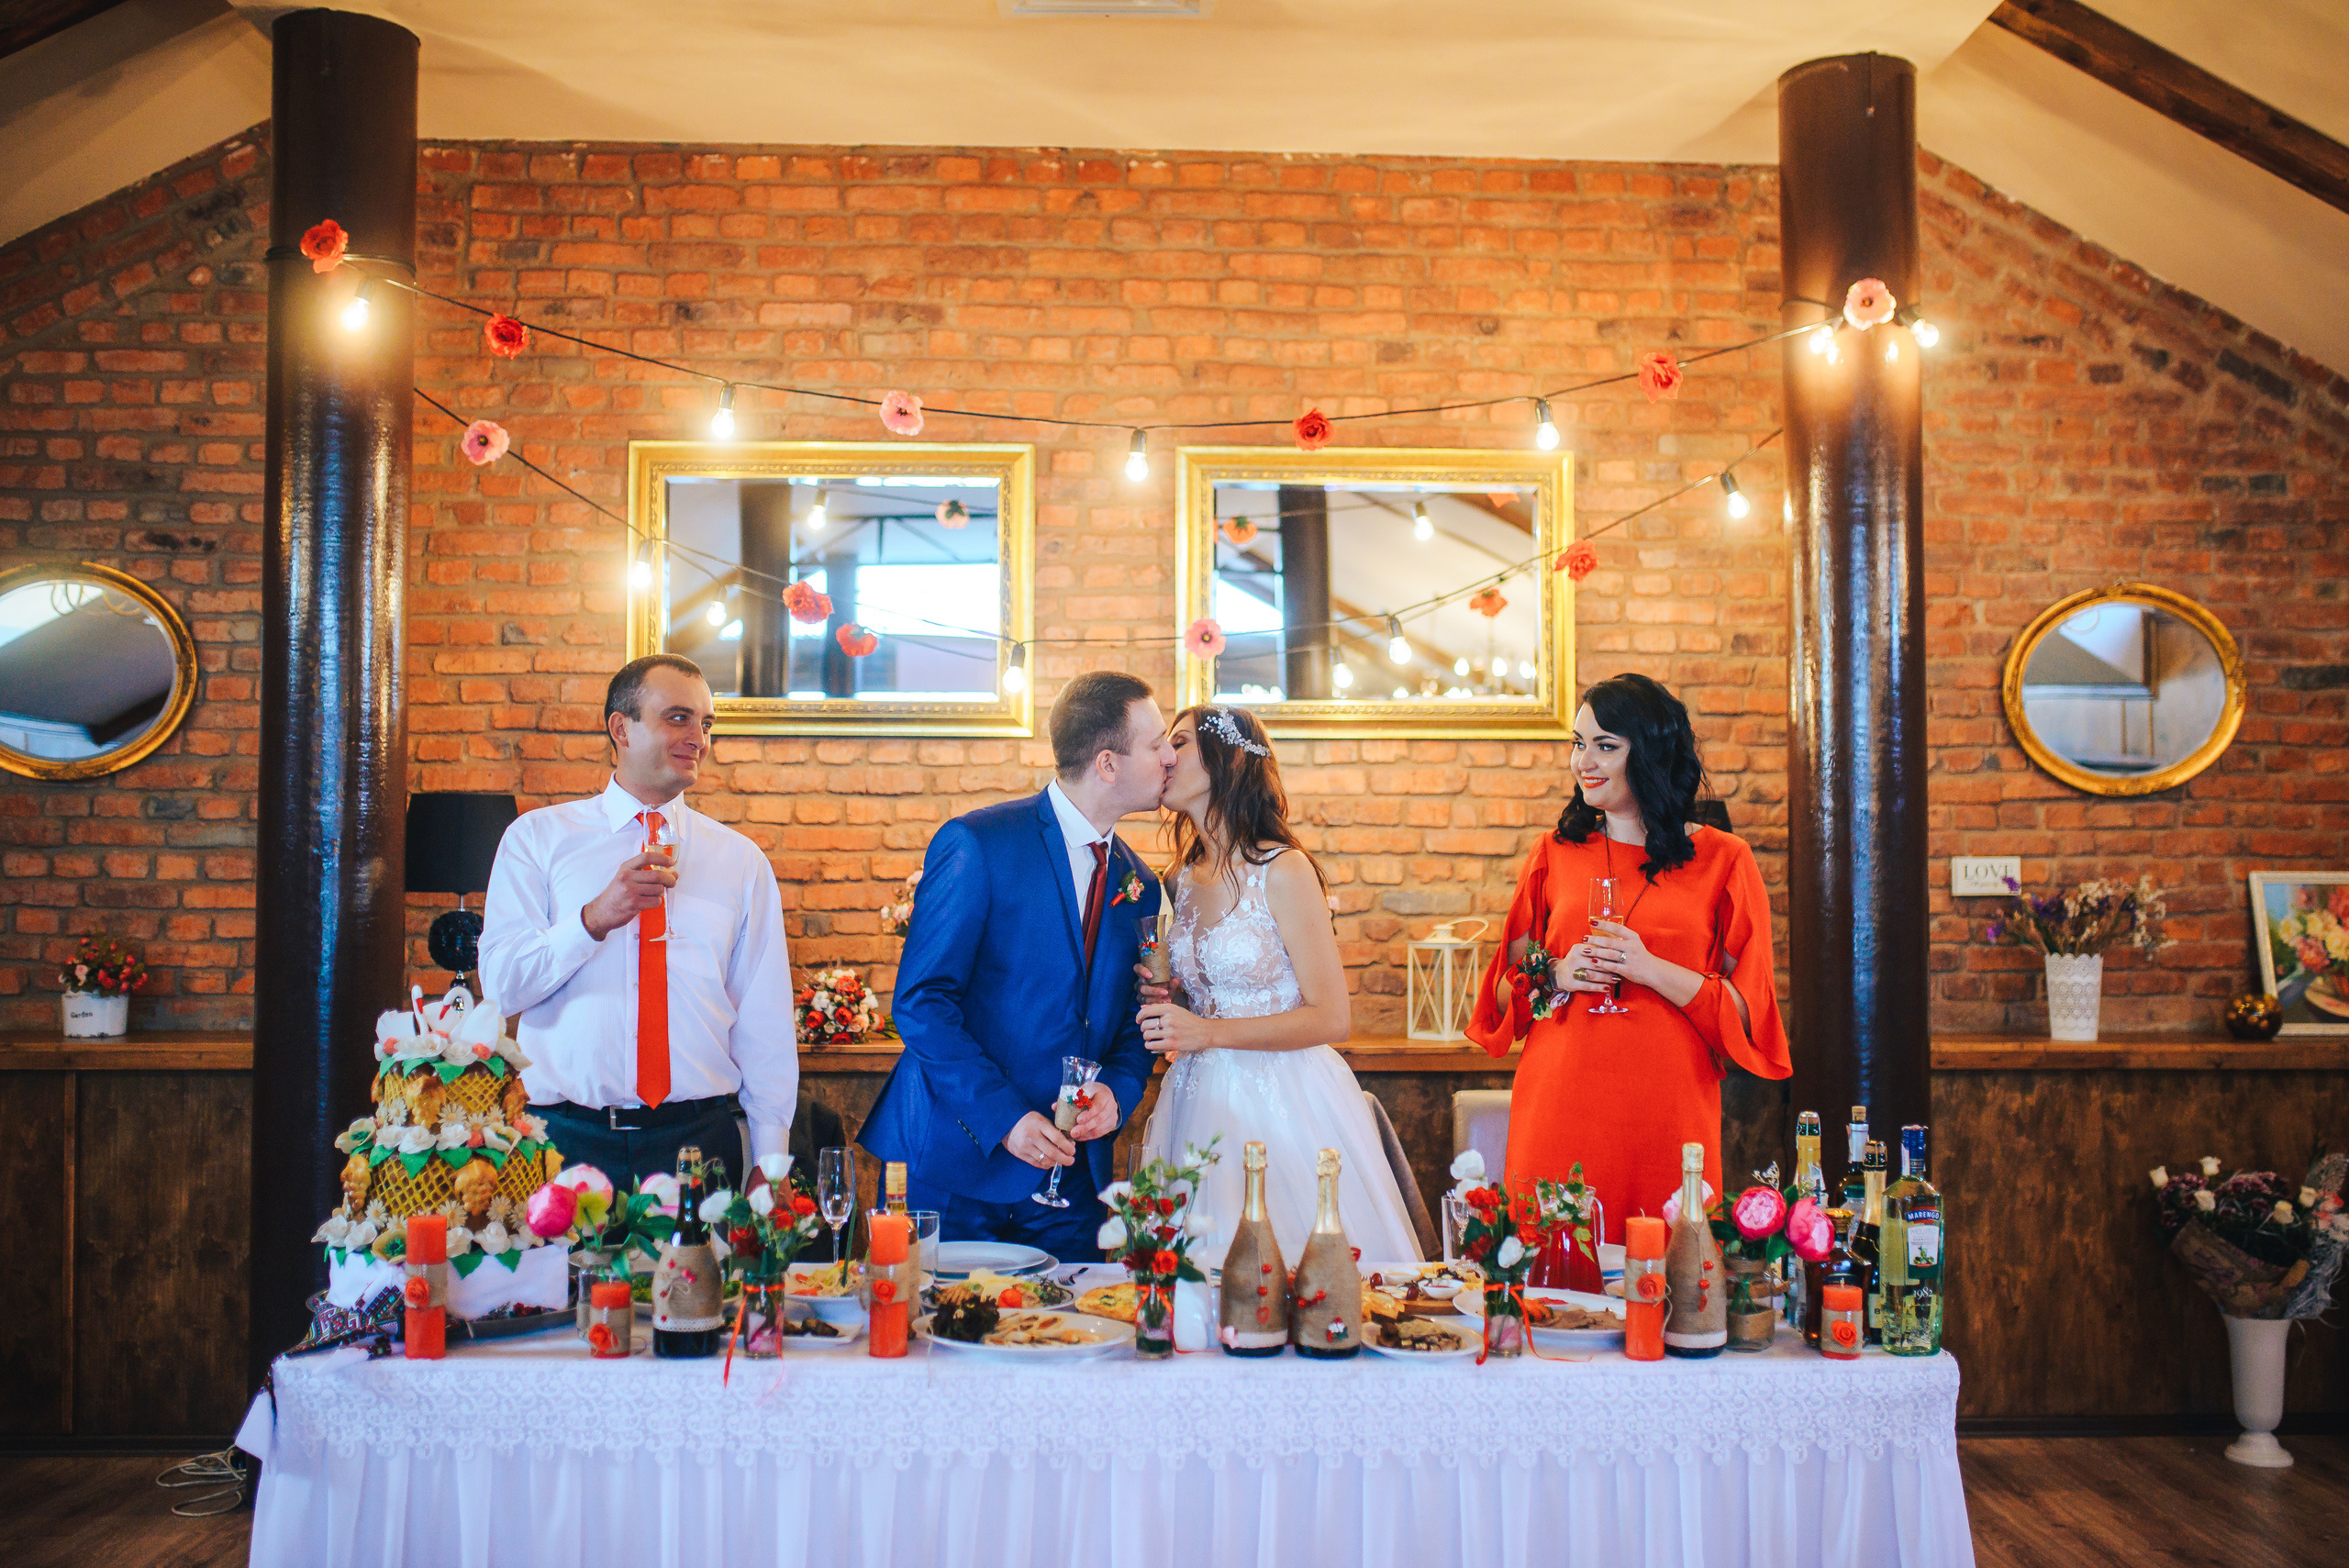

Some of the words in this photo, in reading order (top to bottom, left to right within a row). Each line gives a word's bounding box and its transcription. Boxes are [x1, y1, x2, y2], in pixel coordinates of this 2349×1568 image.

[1964, 863, 2015, 879] LOVE
[1908, 1211, 1940, 1220] MARENGO
[1913, 1285, 1933, 1301] 1982
